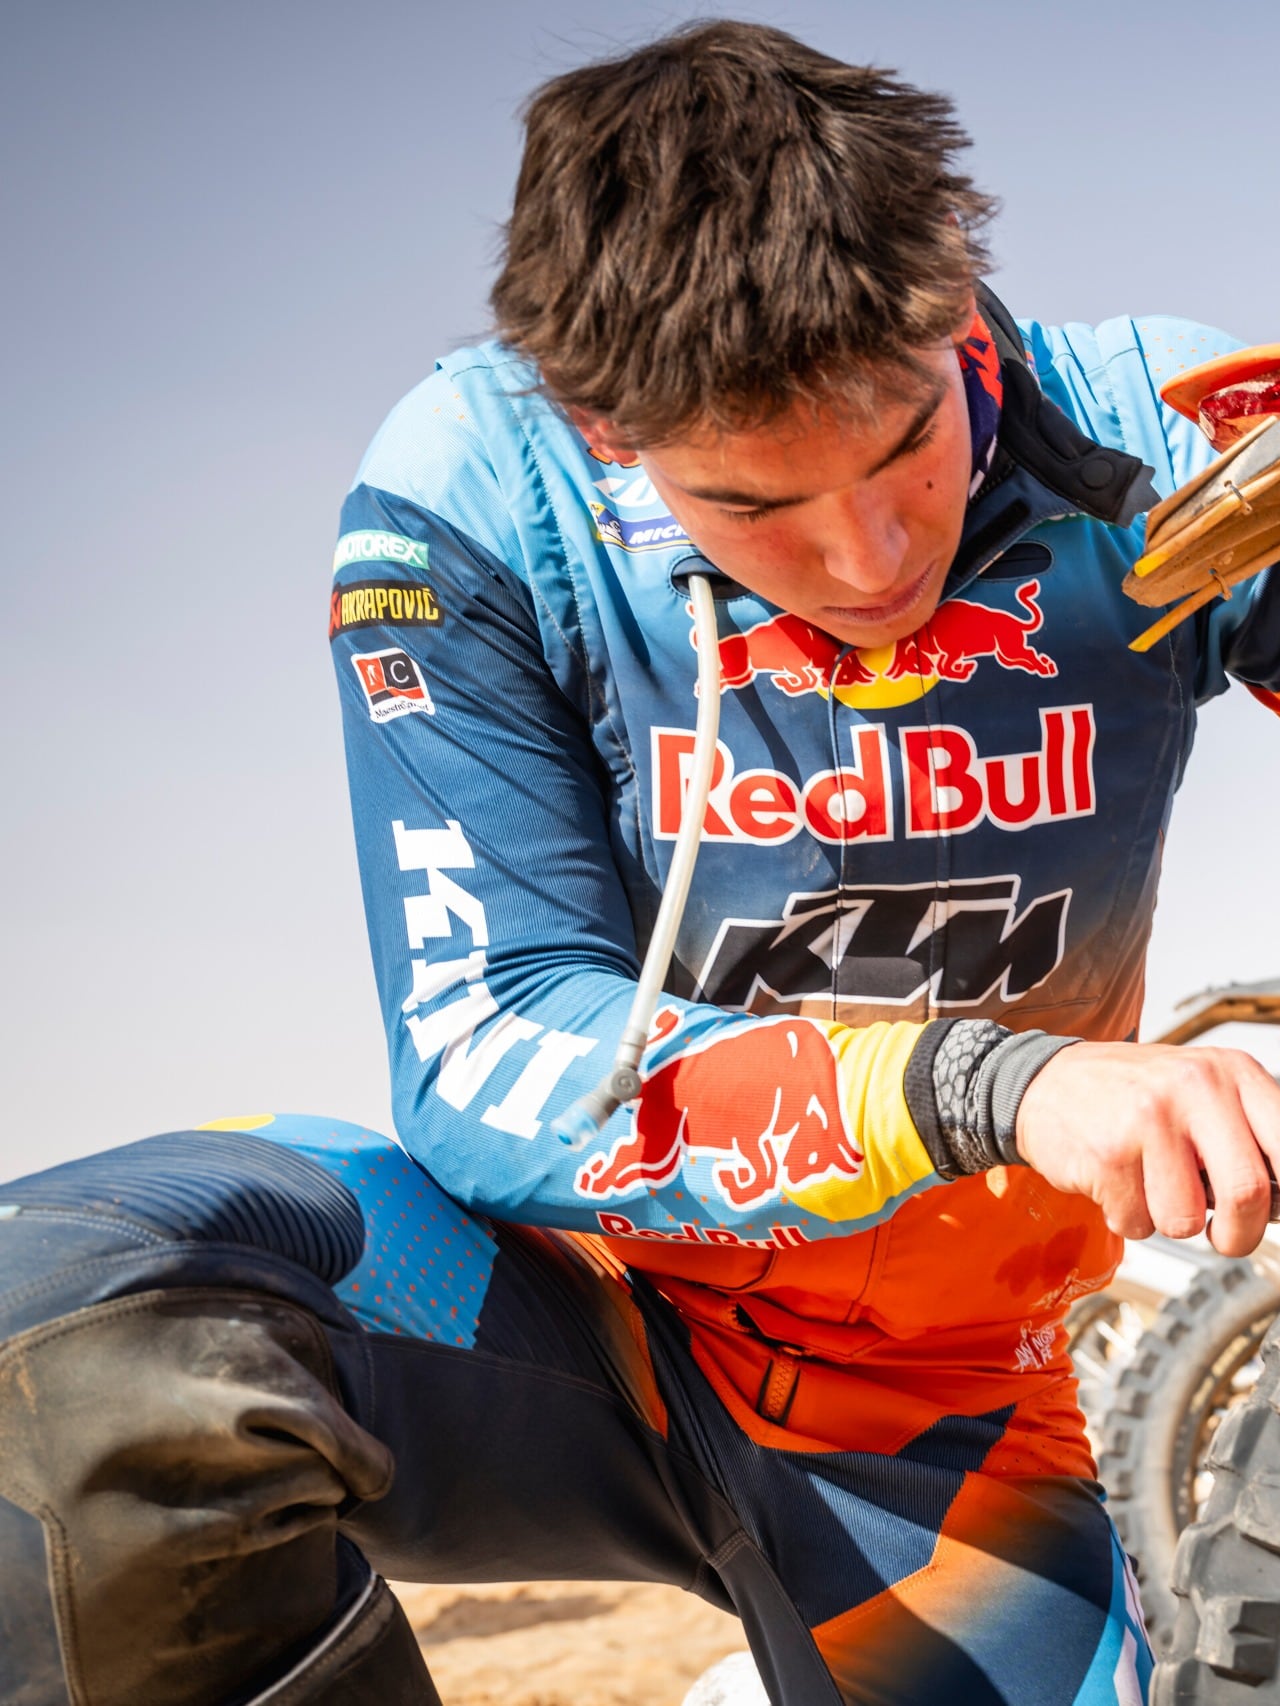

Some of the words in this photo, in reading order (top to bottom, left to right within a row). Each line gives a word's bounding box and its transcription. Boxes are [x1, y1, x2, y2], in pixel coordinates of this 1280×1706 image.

[652, 727, 893, 844] Red
[899, 704, 1096, 837] Bull
[696, 876, 1071, 1009] KTM
